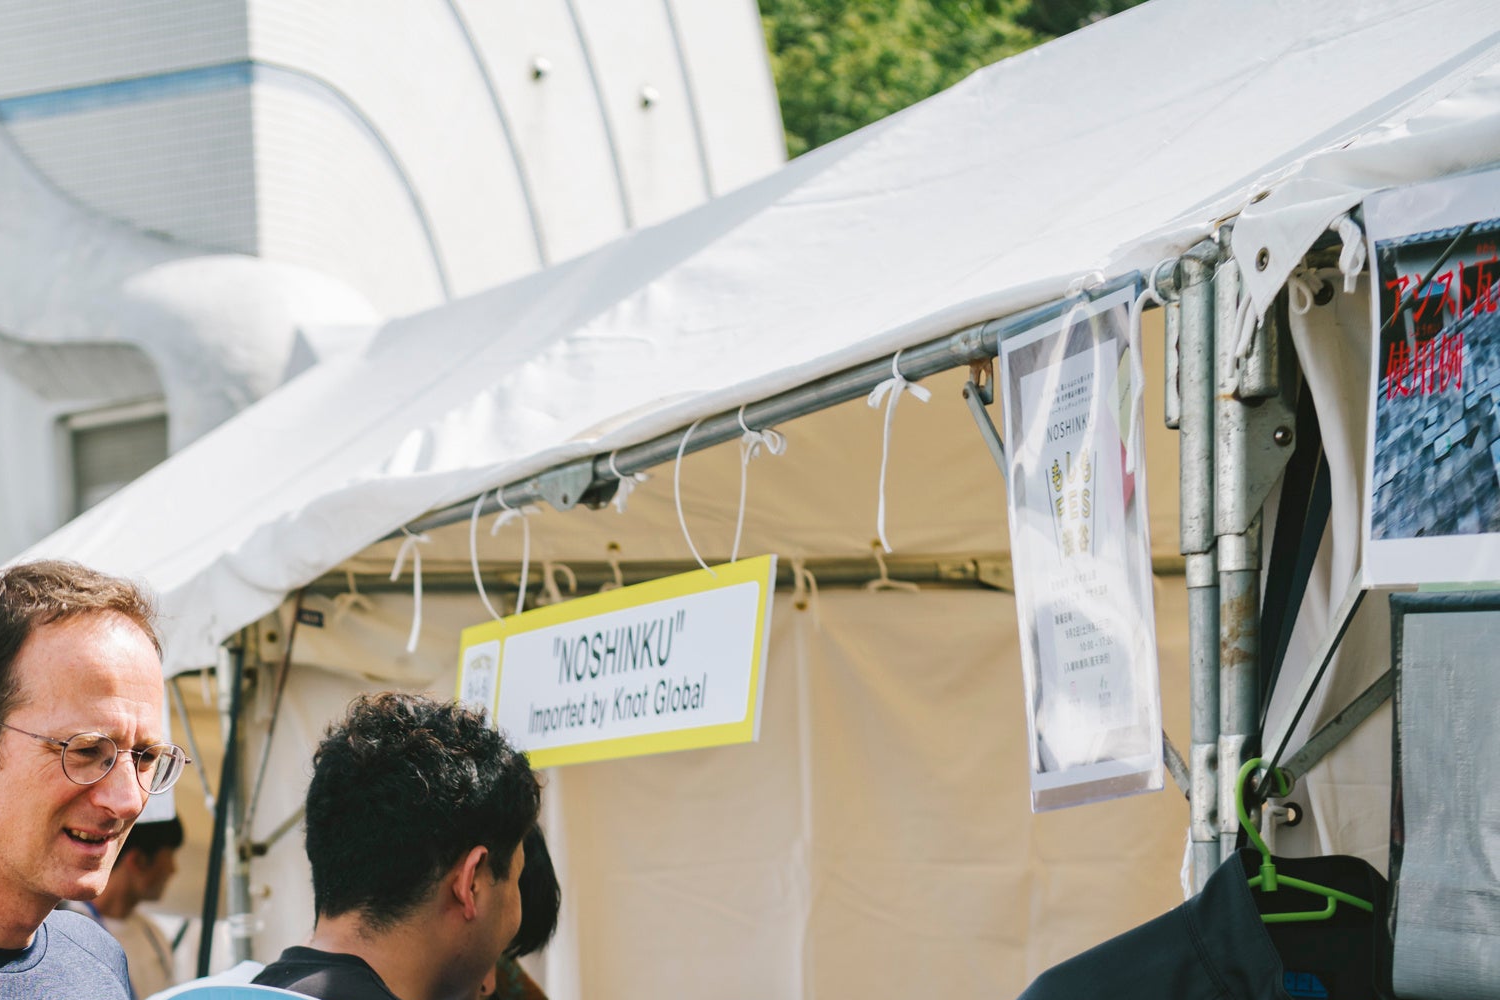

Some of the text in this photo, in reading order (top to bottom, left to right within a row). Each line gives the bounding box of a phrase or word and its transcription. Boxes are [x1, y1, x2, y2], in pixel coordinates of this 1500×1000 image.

[1385, 333, 1464, 401] 使用例
[552, 609, 685, 685] "NOSHINKU"
[529, 672, 708, 738] Imported by Knot Global
